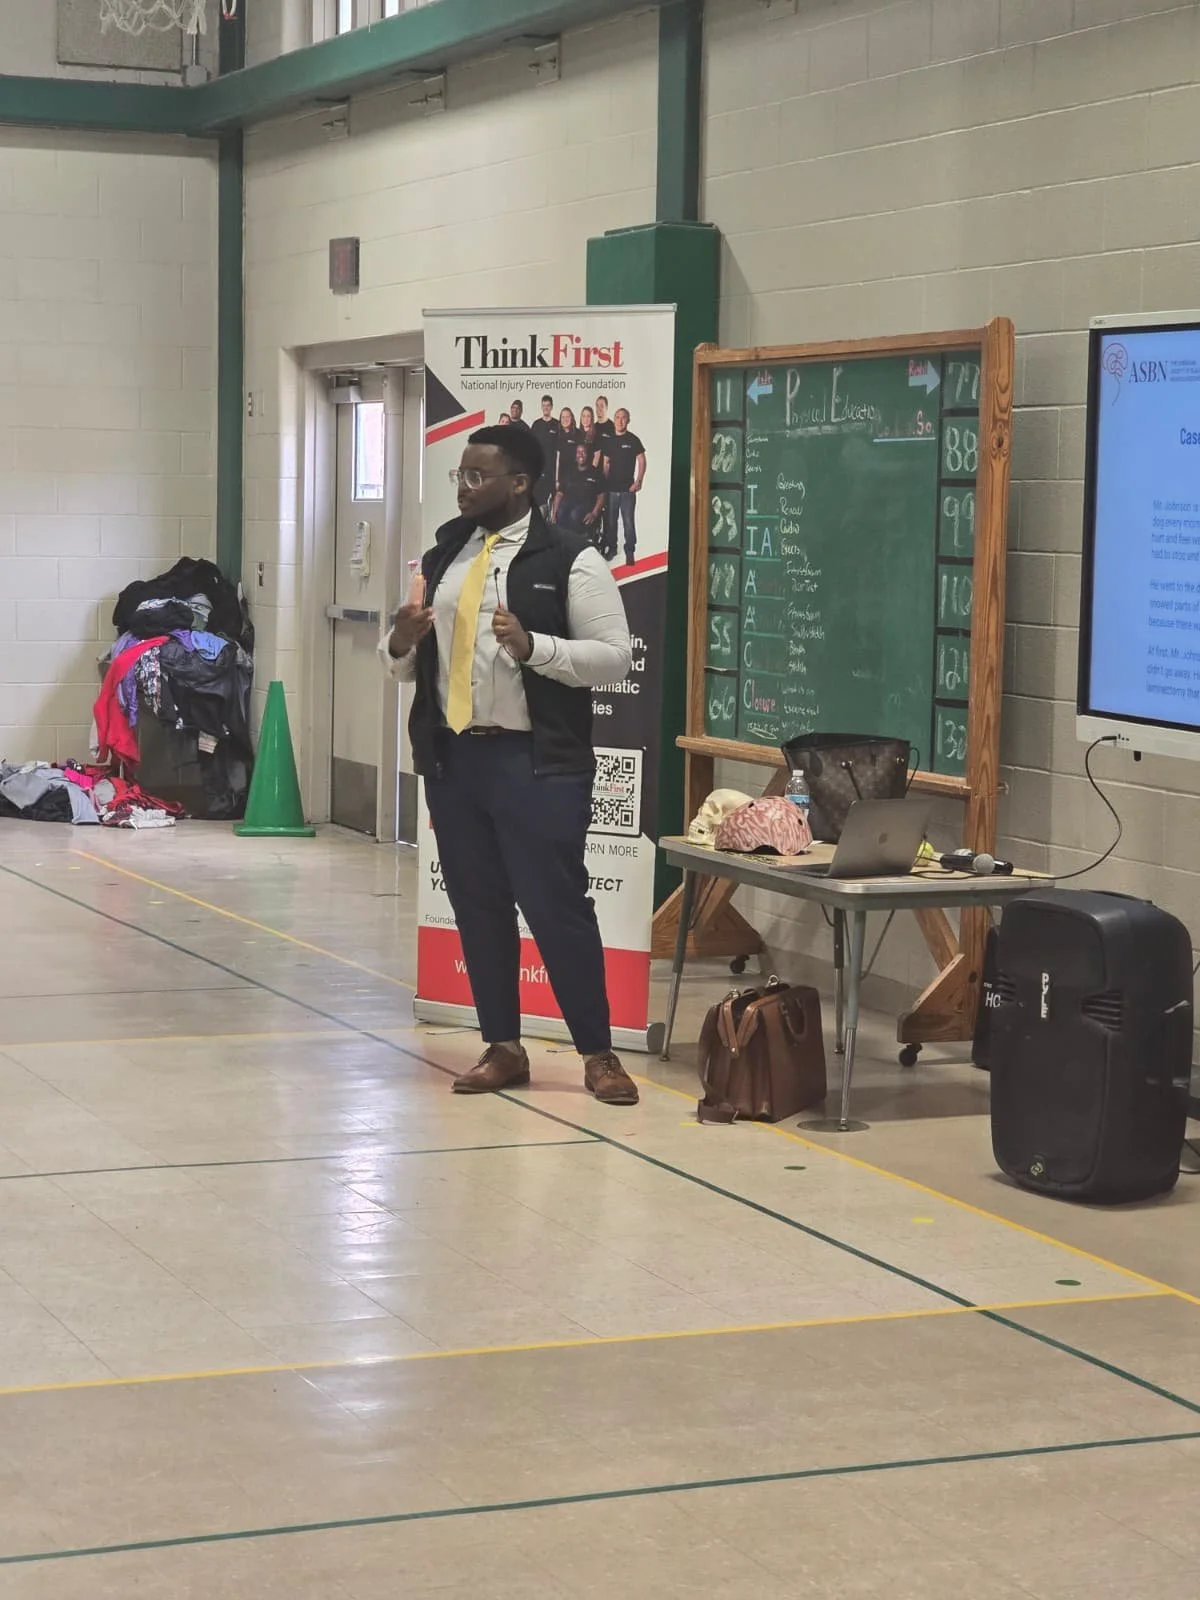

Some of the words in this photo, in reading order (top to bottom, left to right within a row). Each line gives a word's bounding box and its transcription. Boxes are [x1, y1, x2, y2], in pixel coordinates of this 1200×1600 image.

[455, 334, 624, 369] ThinkFirst
[460, 379, 498, 391] National
[499, 379, 524, 393] Injury
[526, 378, 573, 391] Prevention
[575, 378, 626, 390] Foundation
[1129, 360, 1167, 383] ASBN
[716, 378, 731, 413] 11
[945, 425, 978, 473] 88
[943, 492, 975, 548] 99
[609, 844, 639, 858] MORE
[588, 876, 624, 892] TECT
[425, 914, 456, 925] Founde
[1040, 972, 1050, 1019] PYLE
